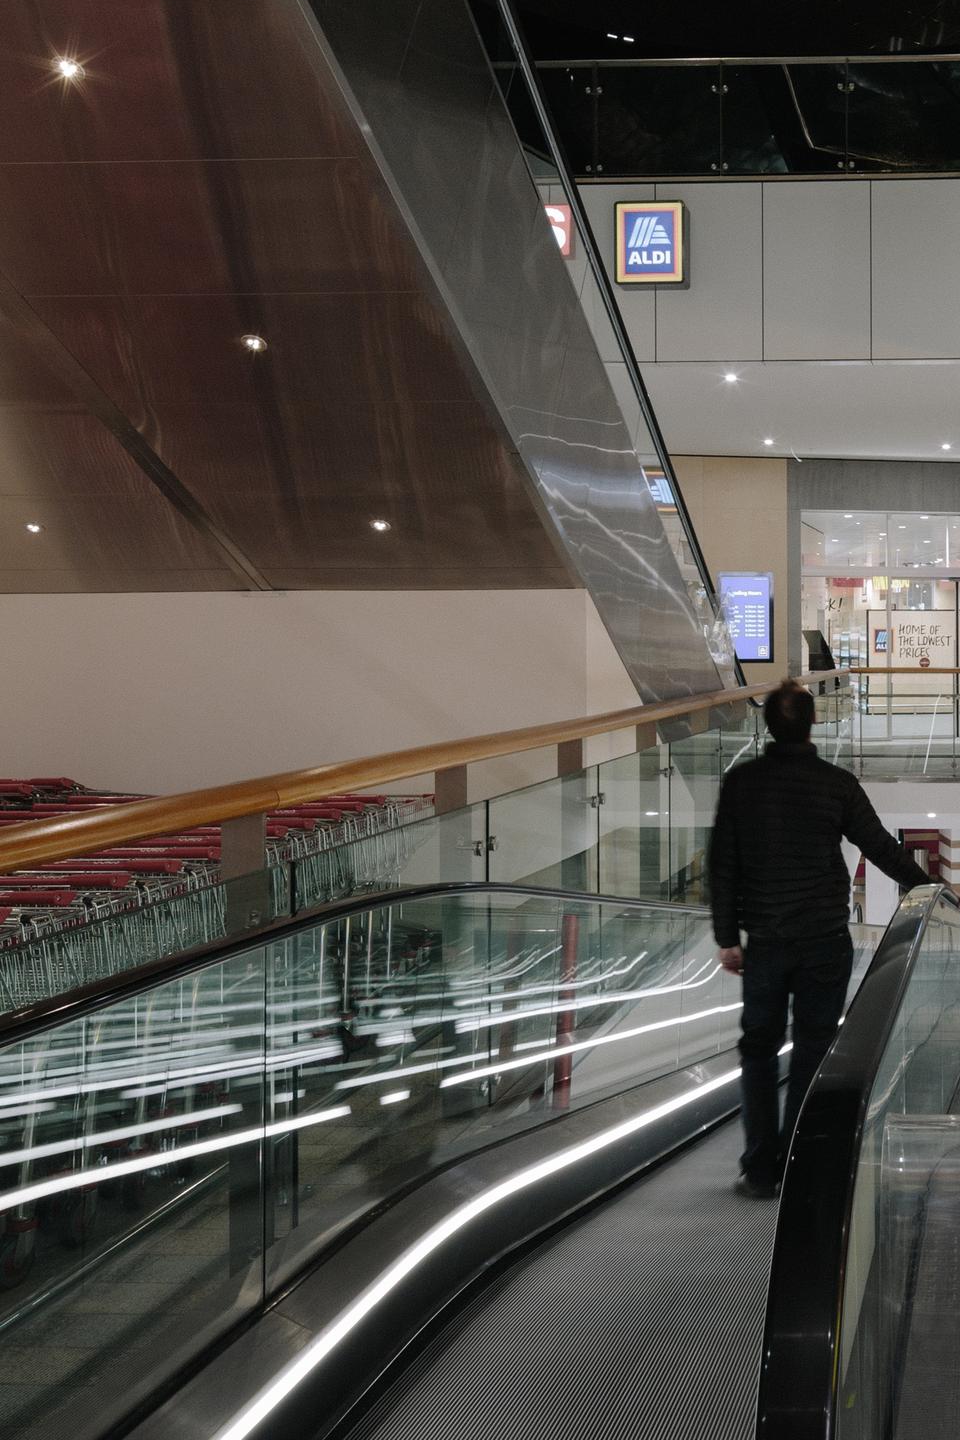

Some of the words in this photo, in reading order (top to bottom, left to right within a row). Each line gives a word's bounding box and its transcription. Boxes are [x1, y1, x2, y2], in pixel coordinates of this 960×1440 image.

[628, 251, 671, 265] ALDI
[898, 624, 926, 635] HOME
[929, 625, 942, 635] OF
[898, 635, 914, 647] THE
[917, 635, 952, 647] LOWEST
[899, 647, 931, 659] PRICES
